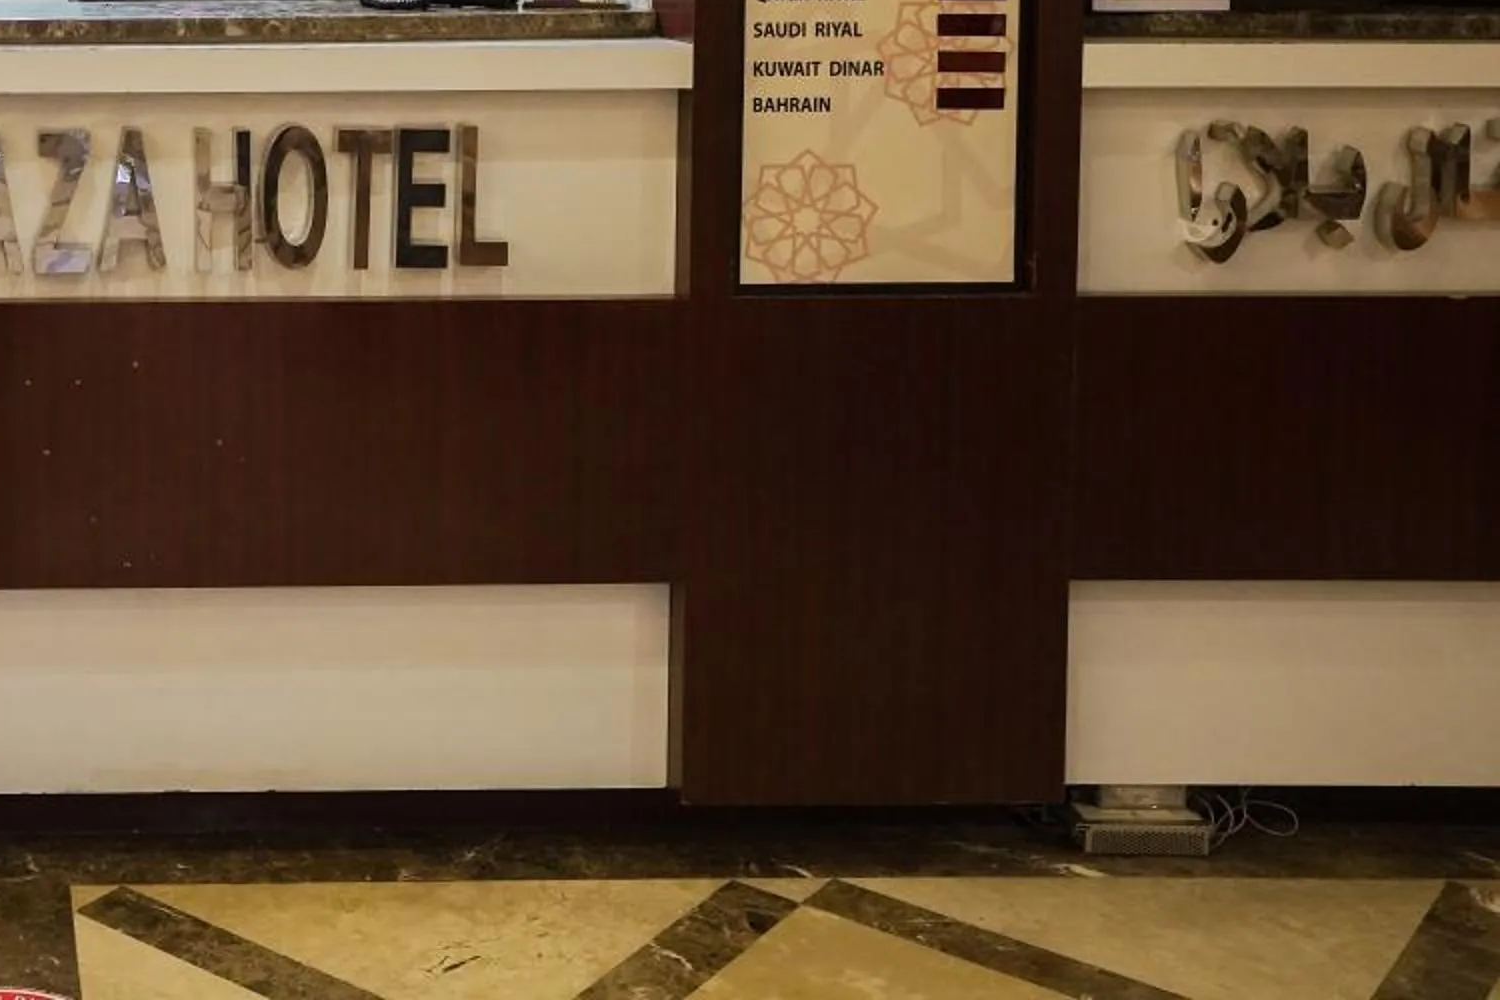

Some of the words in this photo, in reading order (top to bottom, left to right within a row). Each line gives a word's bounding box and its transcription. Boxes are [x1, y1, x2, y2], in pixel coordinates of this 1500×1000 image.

[753, 22, 807, 38] SAUDI
[815, 22, 863, 37] RIYAL
[753, 61, 820, 77] KUWAIT
[829, 61, 884, 76] DINAR
[753, 97, 831, 113] BAHRAIN
[193, 121, 508, 271] HOTEL
